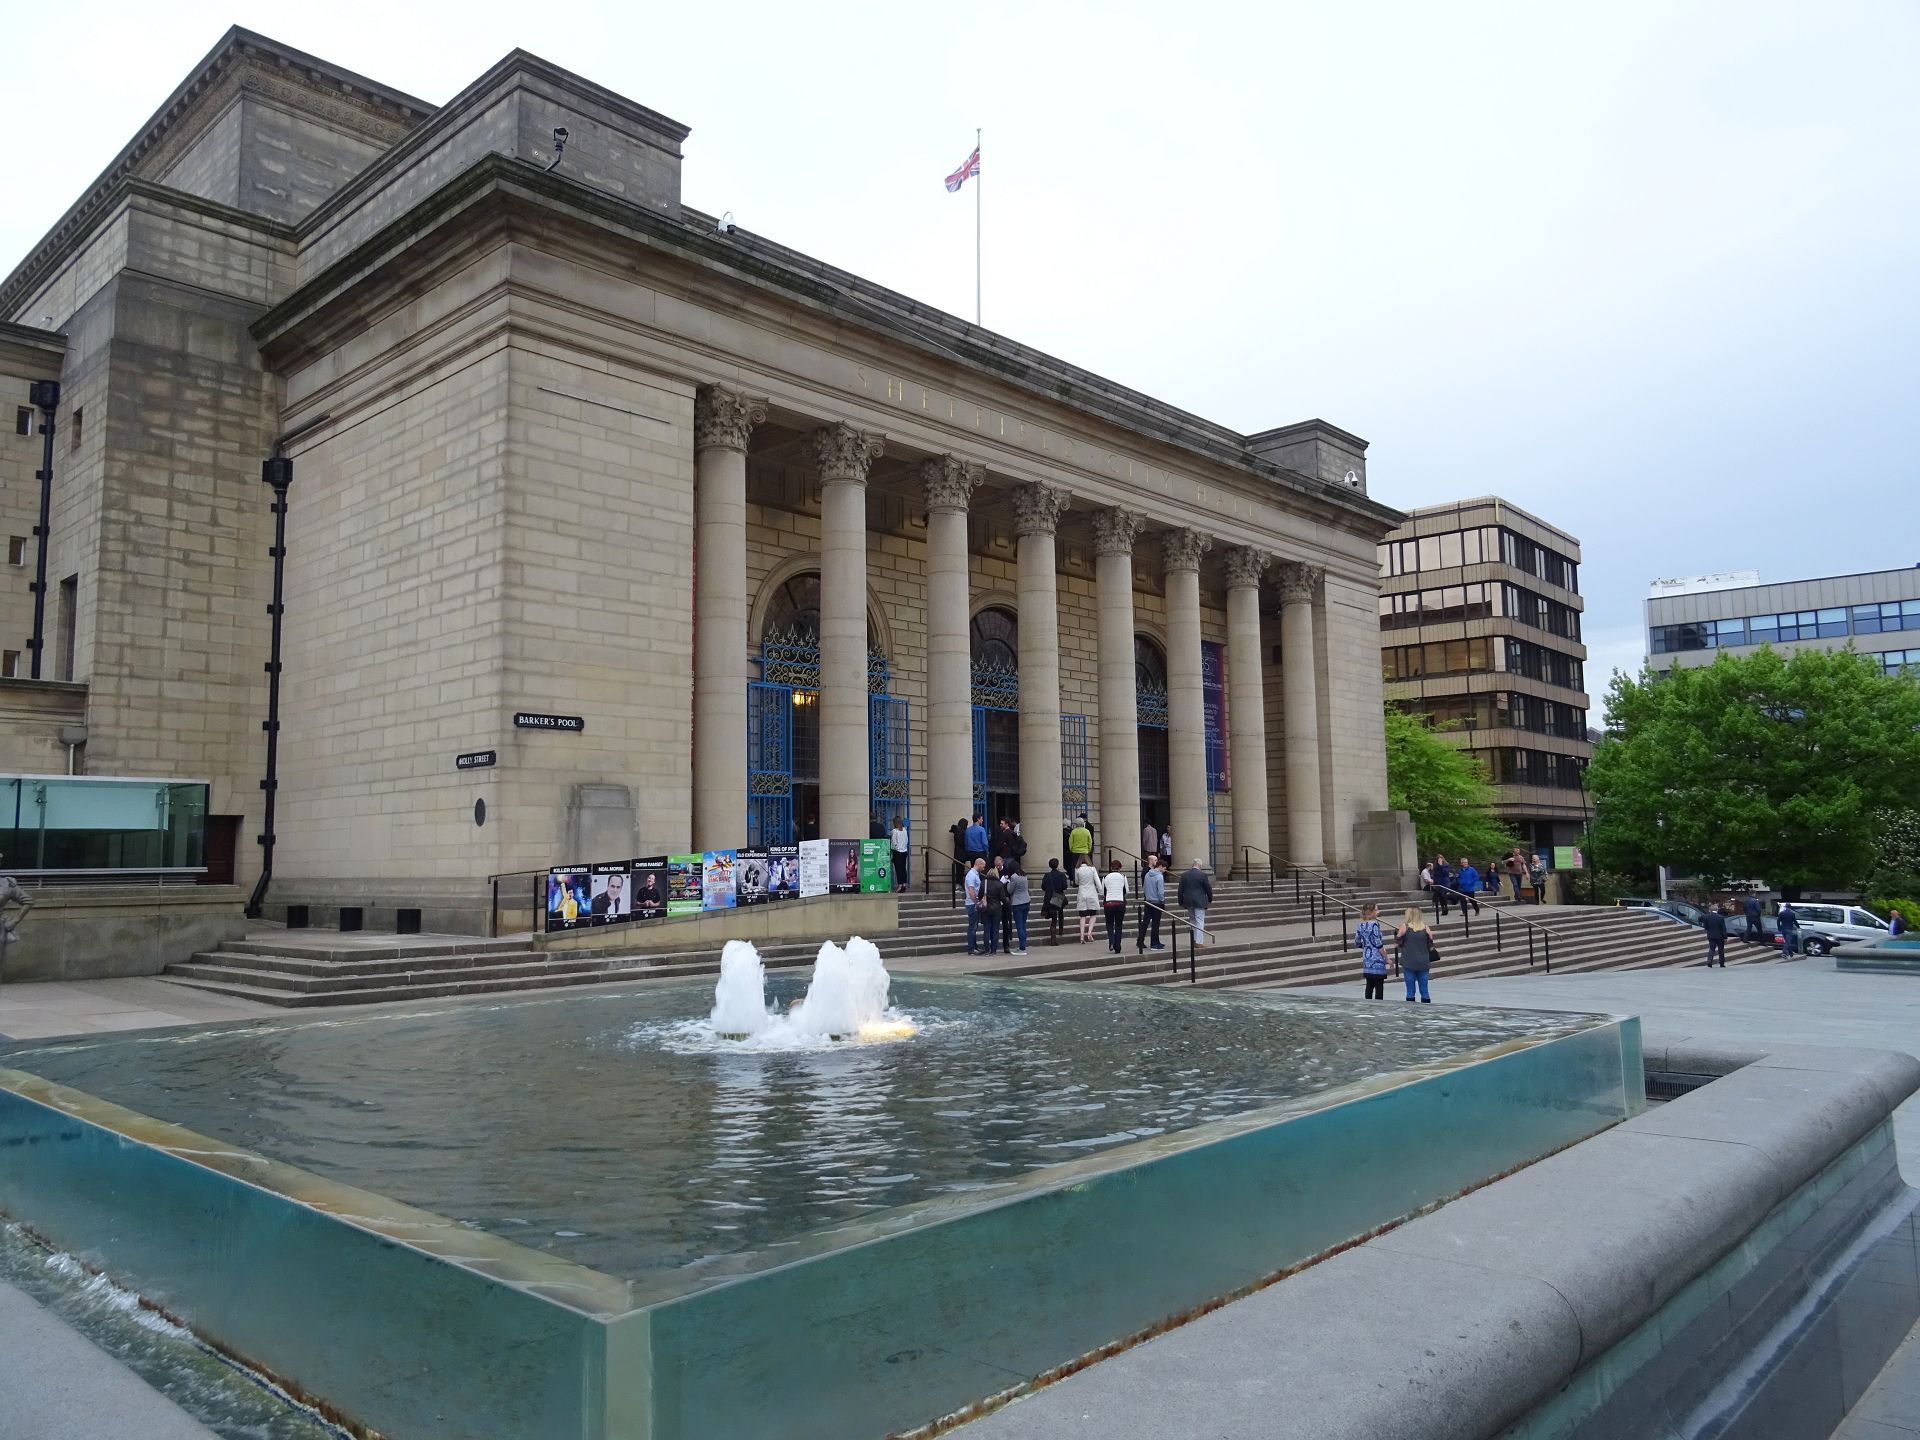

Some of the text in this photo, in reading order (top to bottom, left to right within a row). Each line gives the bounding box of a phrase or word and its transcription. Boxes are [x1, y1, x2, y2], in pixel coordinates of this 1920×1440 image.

[519, 716, 578, 727] BARKER'S POOL
[459, 754, 490, 765] HOLLY STREET
